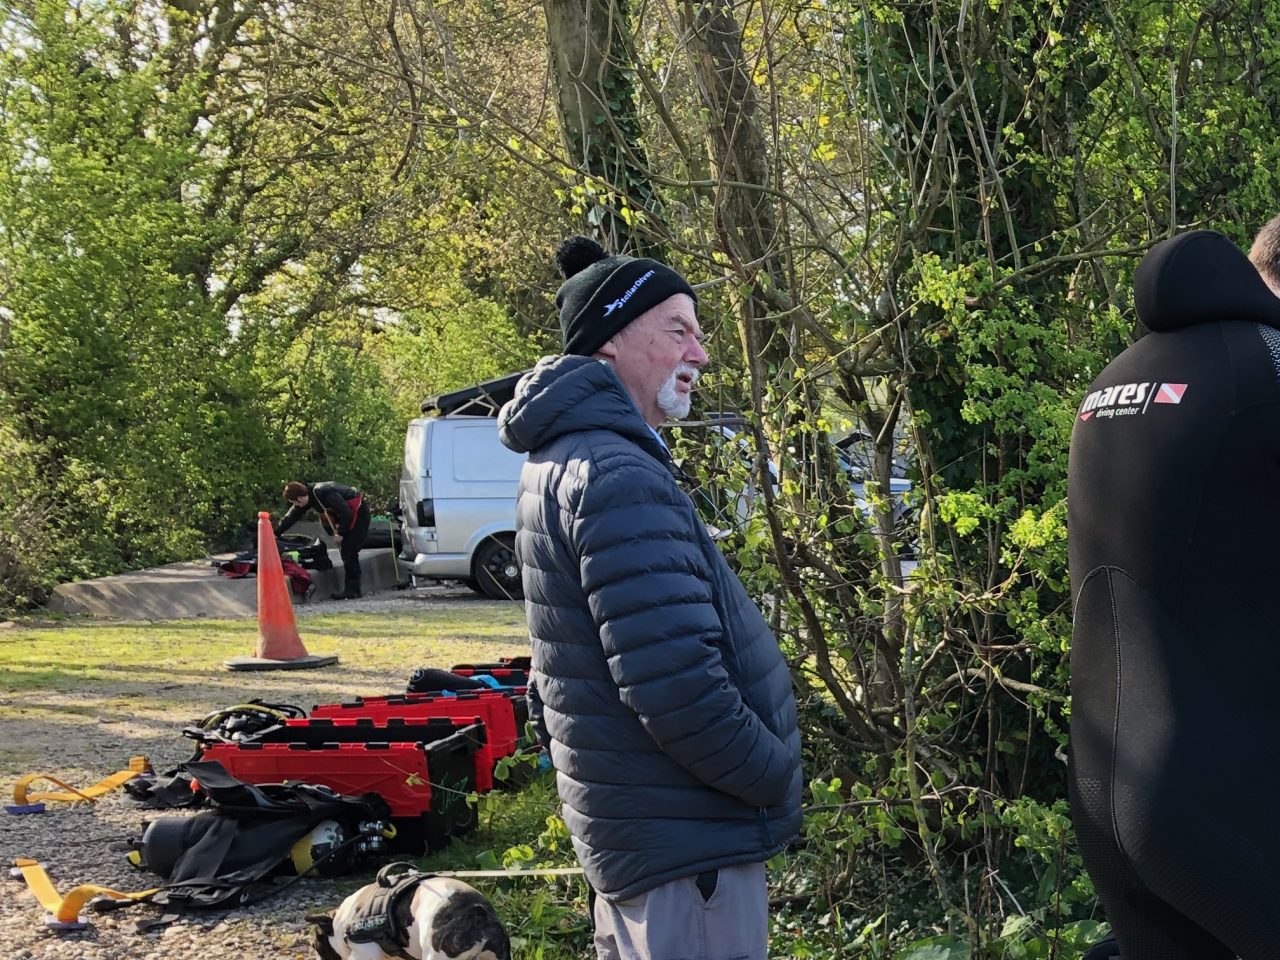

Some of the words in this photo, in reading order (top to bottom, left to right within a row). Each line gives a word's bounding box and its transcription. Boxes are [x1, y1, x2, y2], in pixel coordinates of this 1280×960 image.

[1082, 382, 1150, 413] mares
[1096, 408, 1114, 419] diving
[1115, 406, 1140, 416] center
